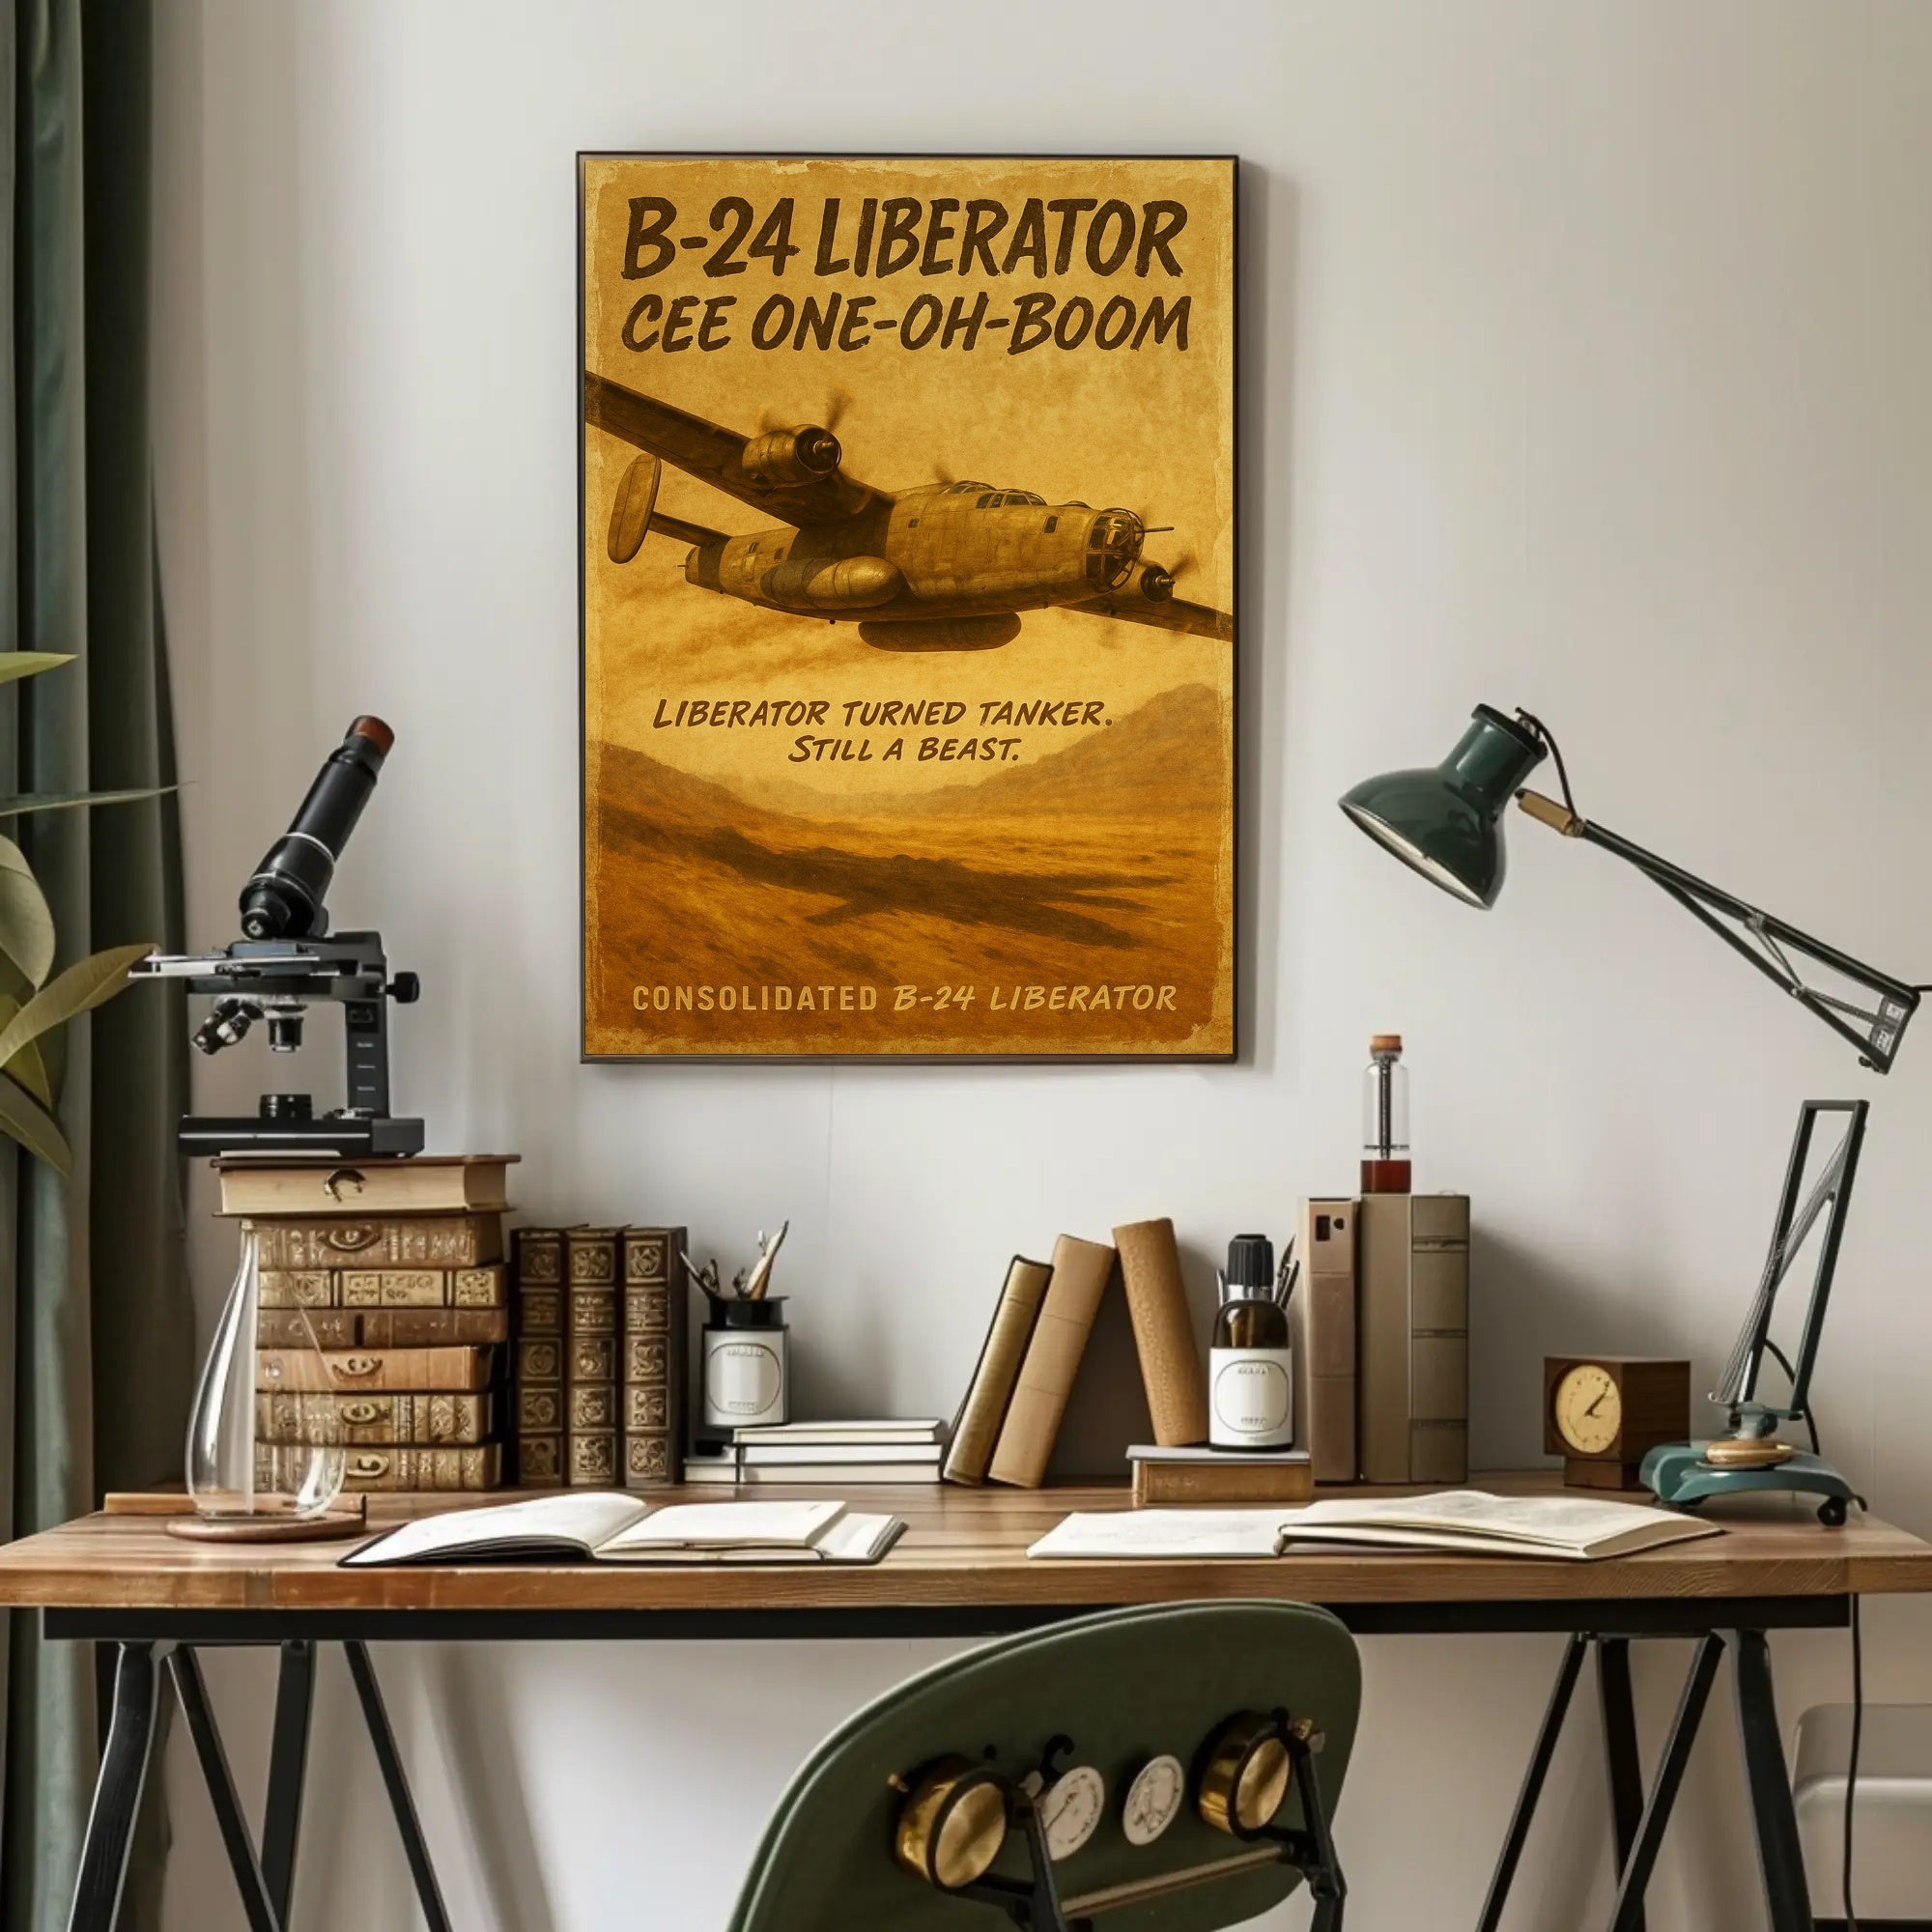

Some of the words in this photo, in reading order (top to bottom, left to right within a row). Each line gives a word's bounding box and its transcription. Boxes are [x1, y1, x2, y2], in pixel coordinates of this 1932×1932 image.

[621, 196, 800, 280] B-24
[815, 197, 1189, 279] LIBERATOR
[621, 294, 737, 353] CEE
[751, 291, 1191, 355] ONE-OH-BOOM
[653, 699, 831, 728] LIBERATOR
[843, 700, 966, 726] TURNED
[979, 700, 1114, 727] TANKER.
[788, 735, 873, 762] STILL
[882, 739, 903, 761] A
[918, 738, 1021, 762] BEAST.
[633, 985, 877, 1011] CONSOLIDATED
[894, 984, 976, 1011] B-24
[989, 984, 1177, 1011] LIBERATOR
